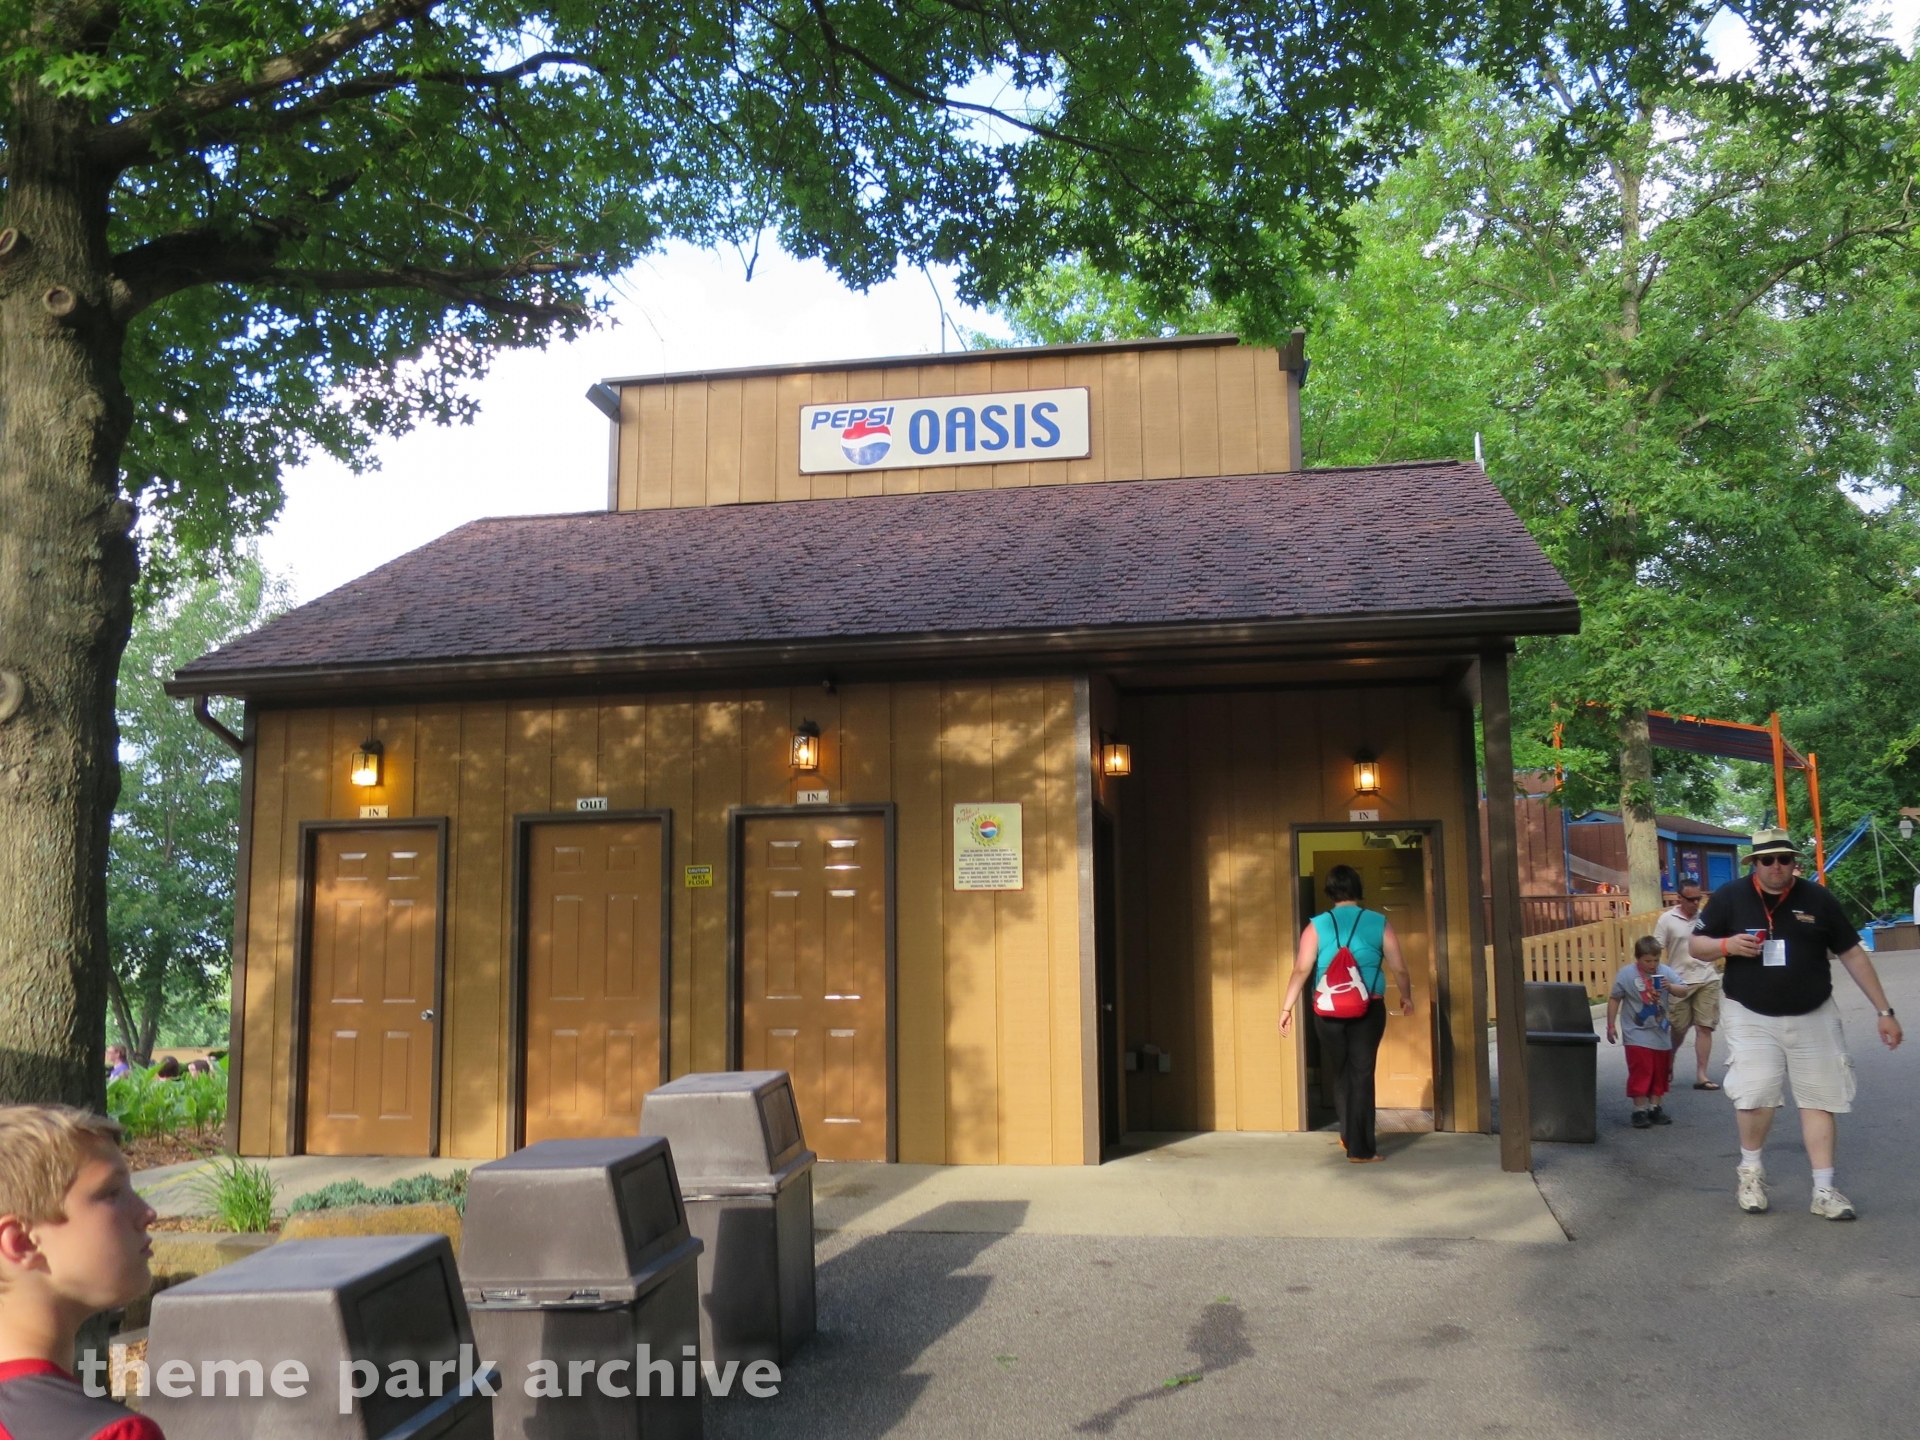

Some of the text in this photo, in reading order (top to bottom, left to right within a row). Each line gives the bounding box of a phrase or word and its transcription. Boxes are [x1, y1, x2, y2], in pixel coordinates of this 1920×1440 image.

[811, 402, 1061, 455] PEPSI OASIS
[807, 793, 819, 802] IN
[580, 800, 604, 810] OUT
[368, 808, 380, 818] IN
[1359, 811, 1370, 820] IN
